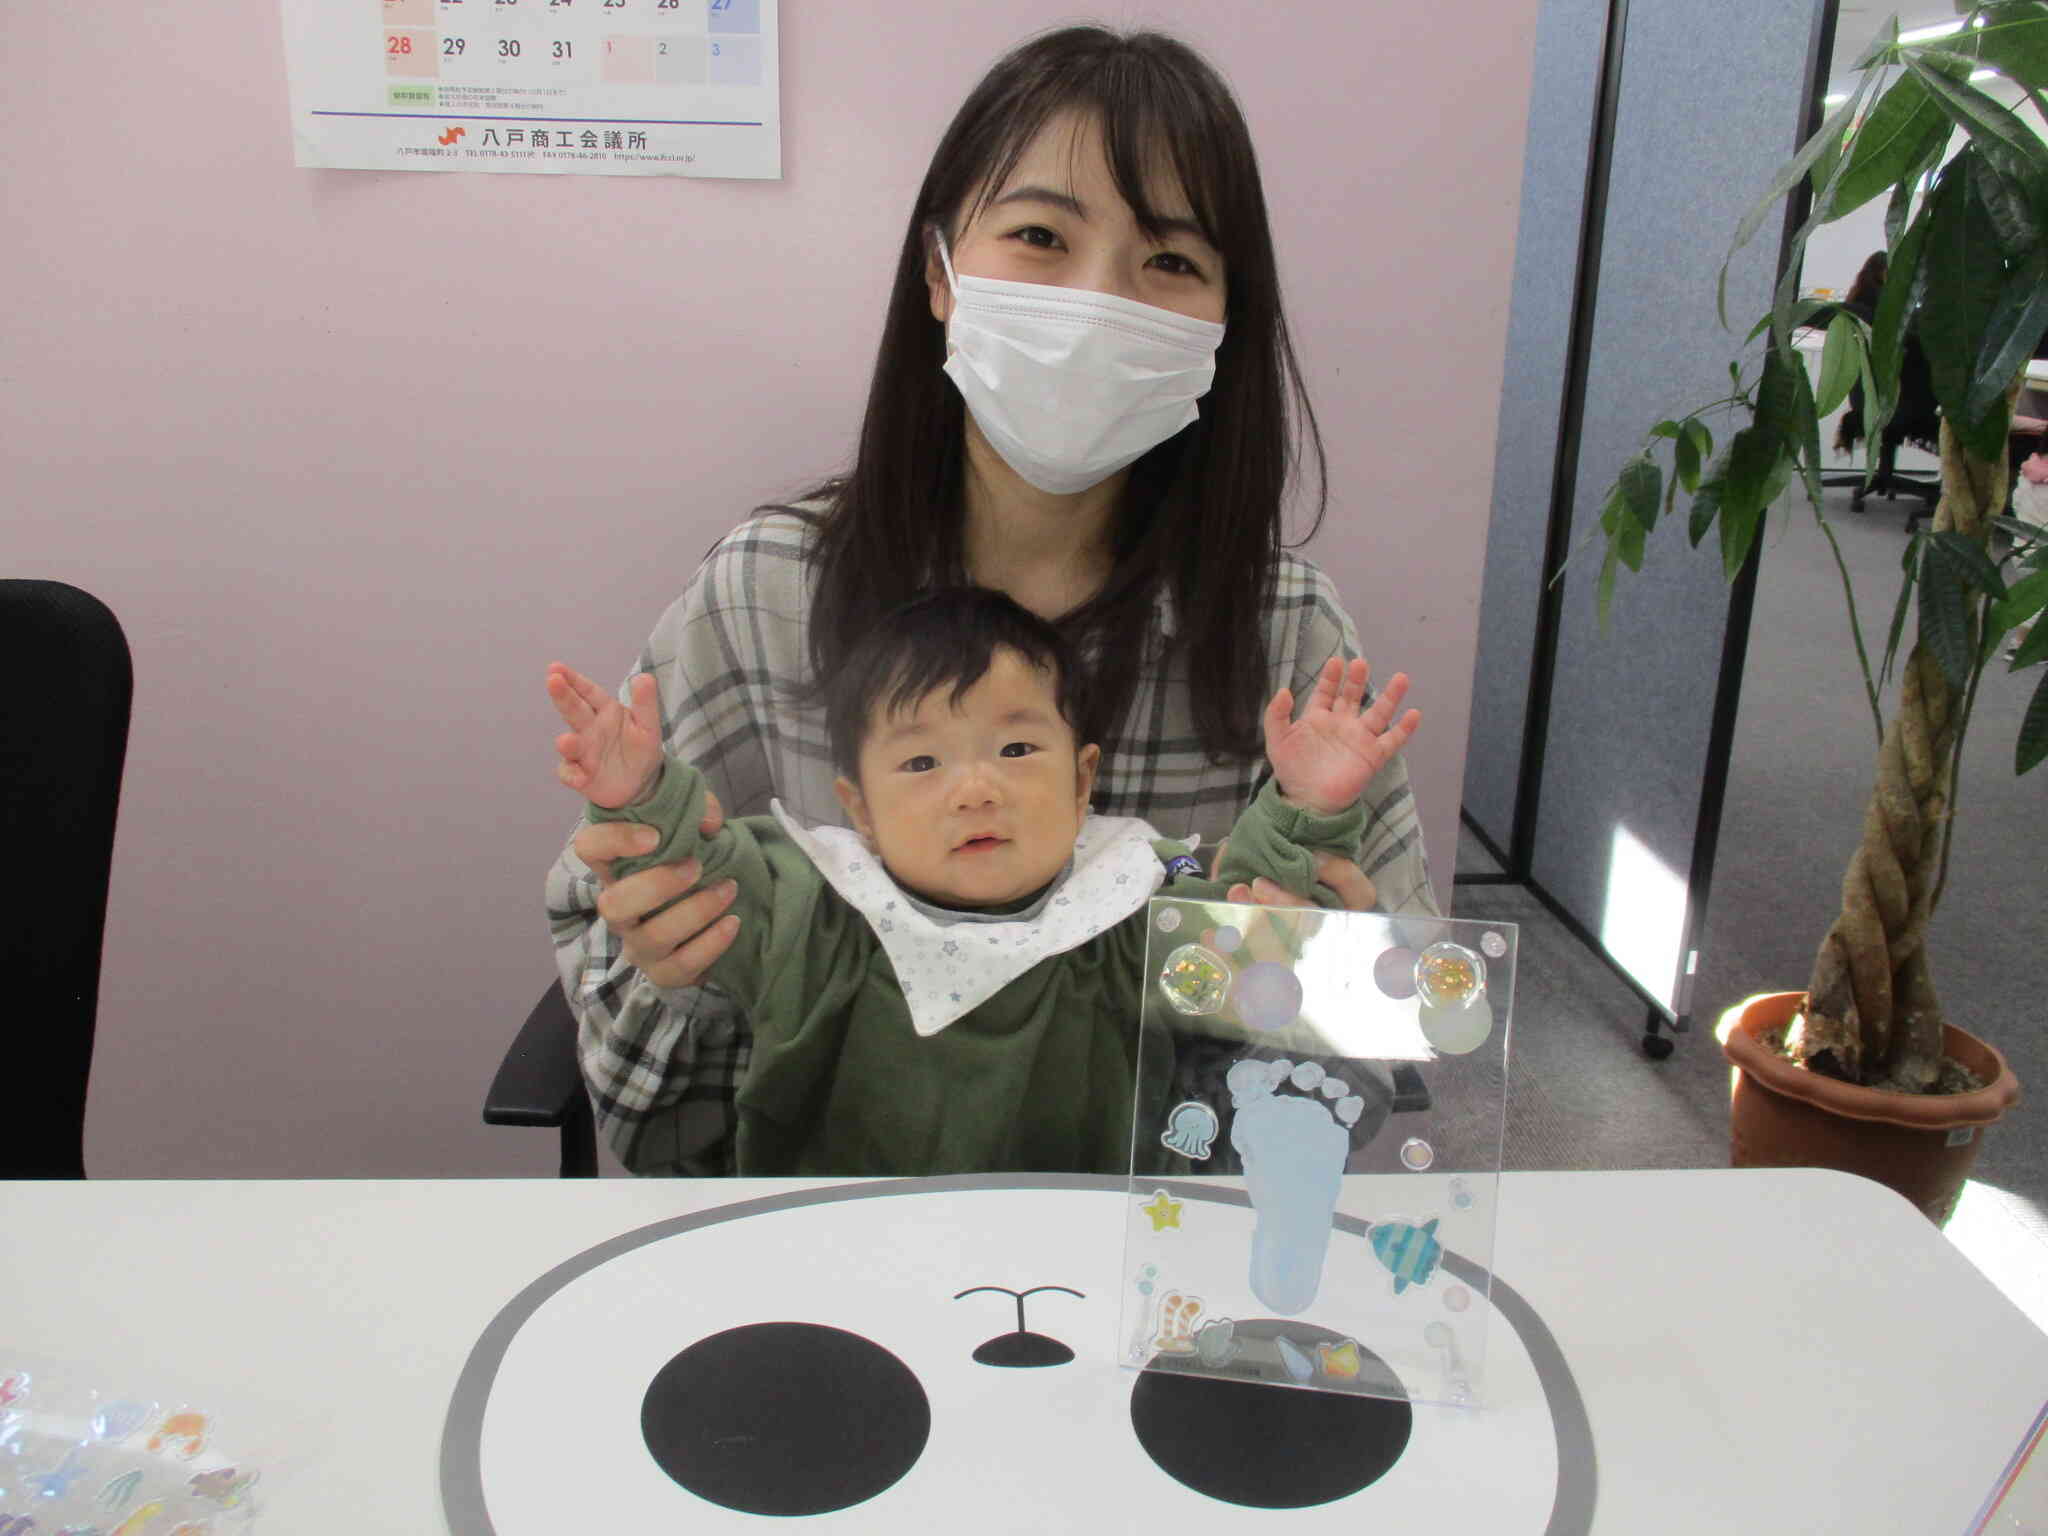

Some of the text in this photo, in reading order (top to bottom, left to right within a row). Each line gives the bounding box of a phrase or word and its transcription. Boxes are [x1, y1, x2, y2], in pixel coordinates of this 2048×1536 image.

[387, 36, 721, 58] 28 29 30 31 1 2 3
[482, 128, 648, 150] 八戸商工会議所
